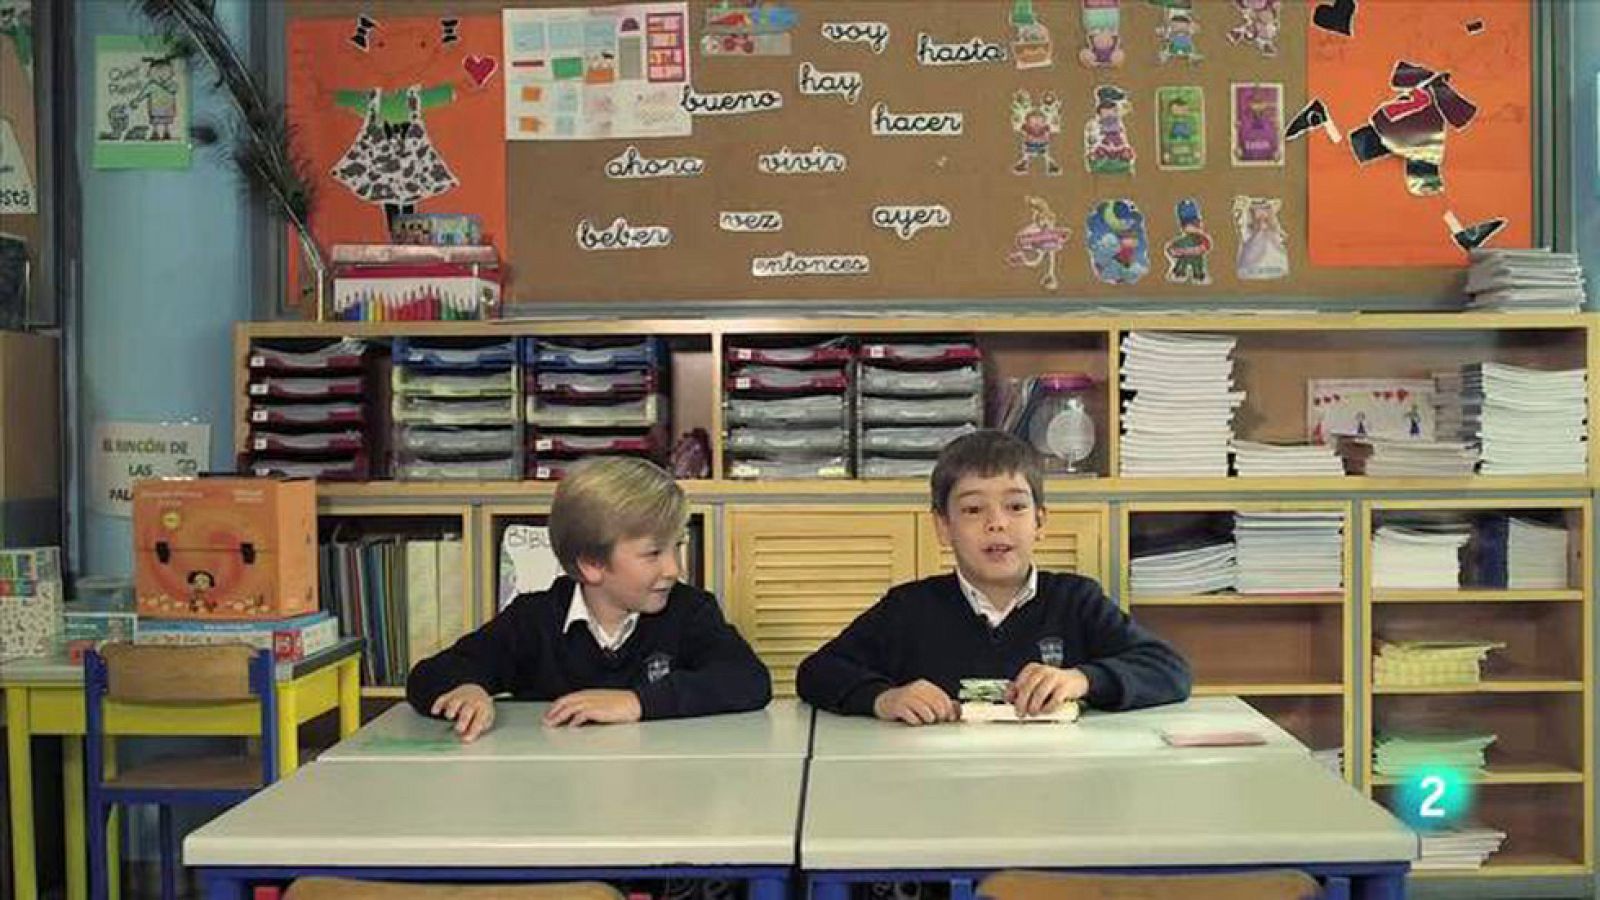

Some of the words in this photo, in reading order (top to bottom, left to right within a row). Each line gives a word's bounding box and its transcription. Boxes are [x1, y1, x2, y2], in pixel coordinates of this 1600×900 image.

[824, 24, 888, 51] voy
[917, 34, 1006, 61] hasta
[801, 64, 861, 104] hay
[681, 85, 781, 111] bueno
[875, 103, 961, 130] hacer
[607, 149, 703, 176] ahora
[761, 148, 843, 170] vivir
[580, 220, 673, 248] beber
[722, 213, 780, 229] vez
[873, 208, 947, 236] ayer
[755, 255, 866, 272] entonces
[170, 440, 188, 455] DE
[128, 463, 153, 477] LAS
